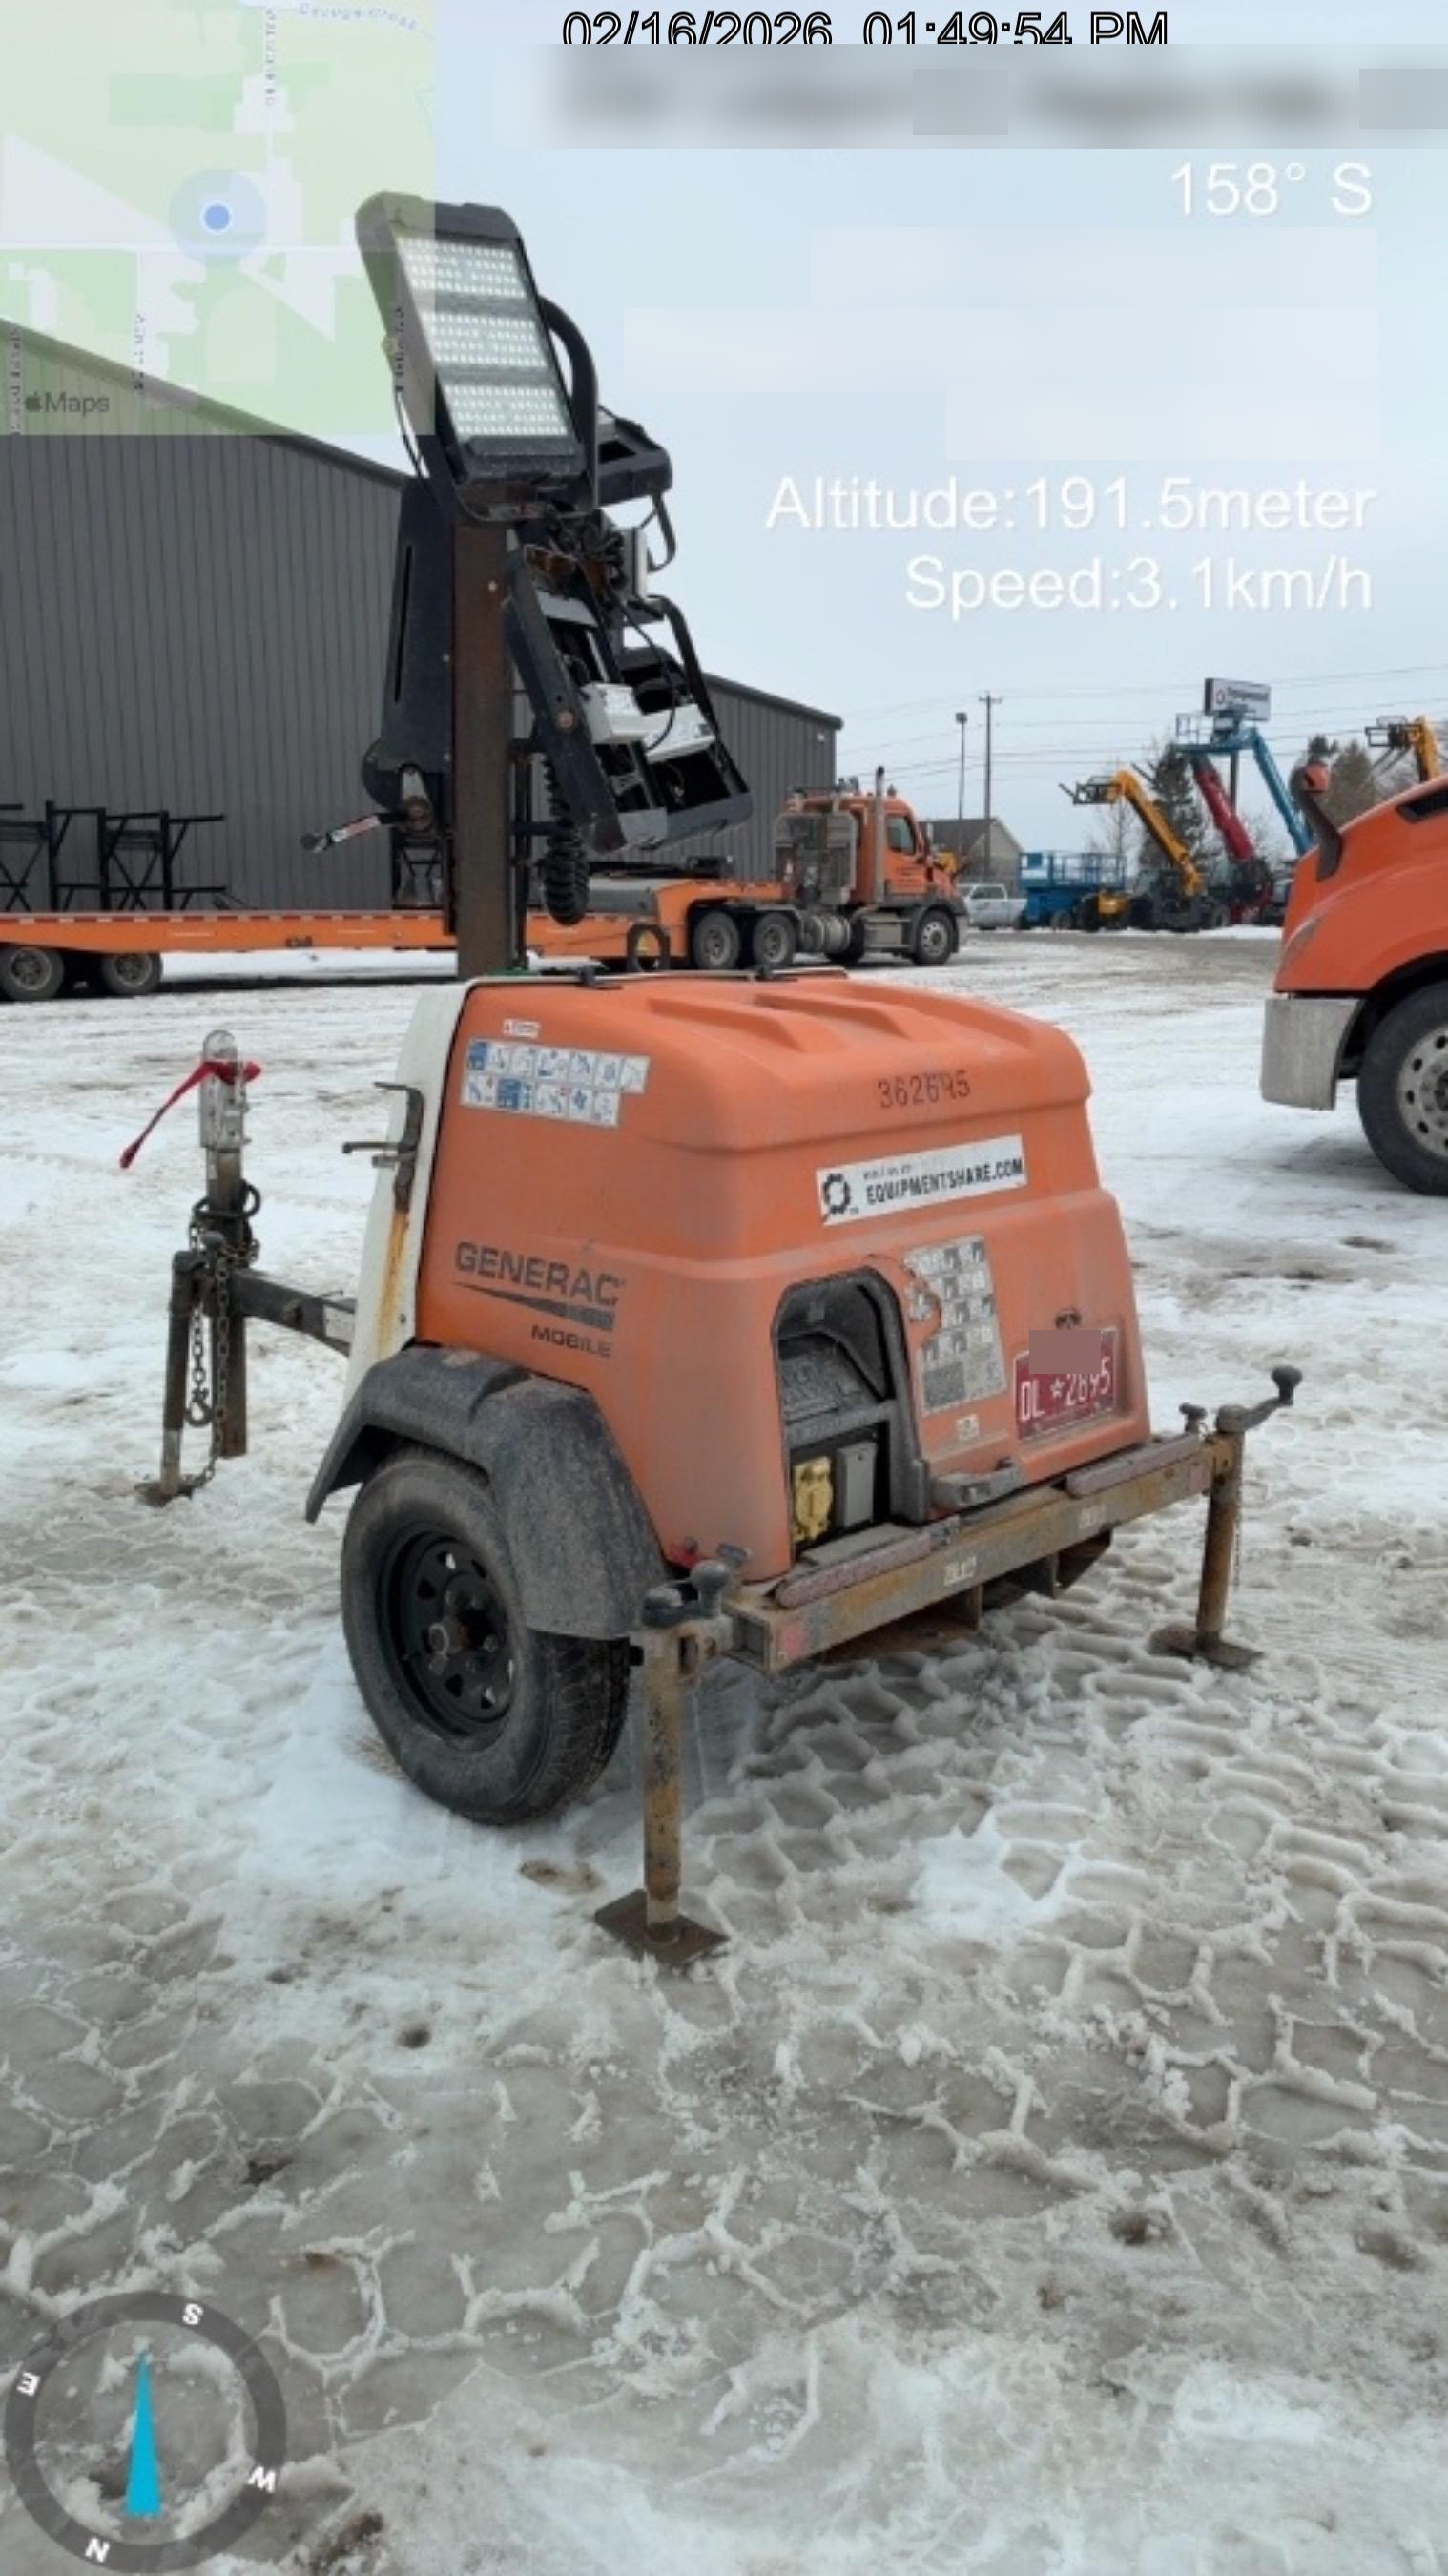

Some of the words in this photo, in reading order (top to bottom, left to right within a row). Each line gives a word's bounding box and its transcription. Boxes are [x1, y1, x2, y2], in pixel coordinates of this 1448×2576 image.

[865, 1158, 1024, 1205] EQUIPMENTSHARE.COM
[455, 1241, 620, 1306] GENERAC
[531, 1324, 612, 1358] MOBILE
